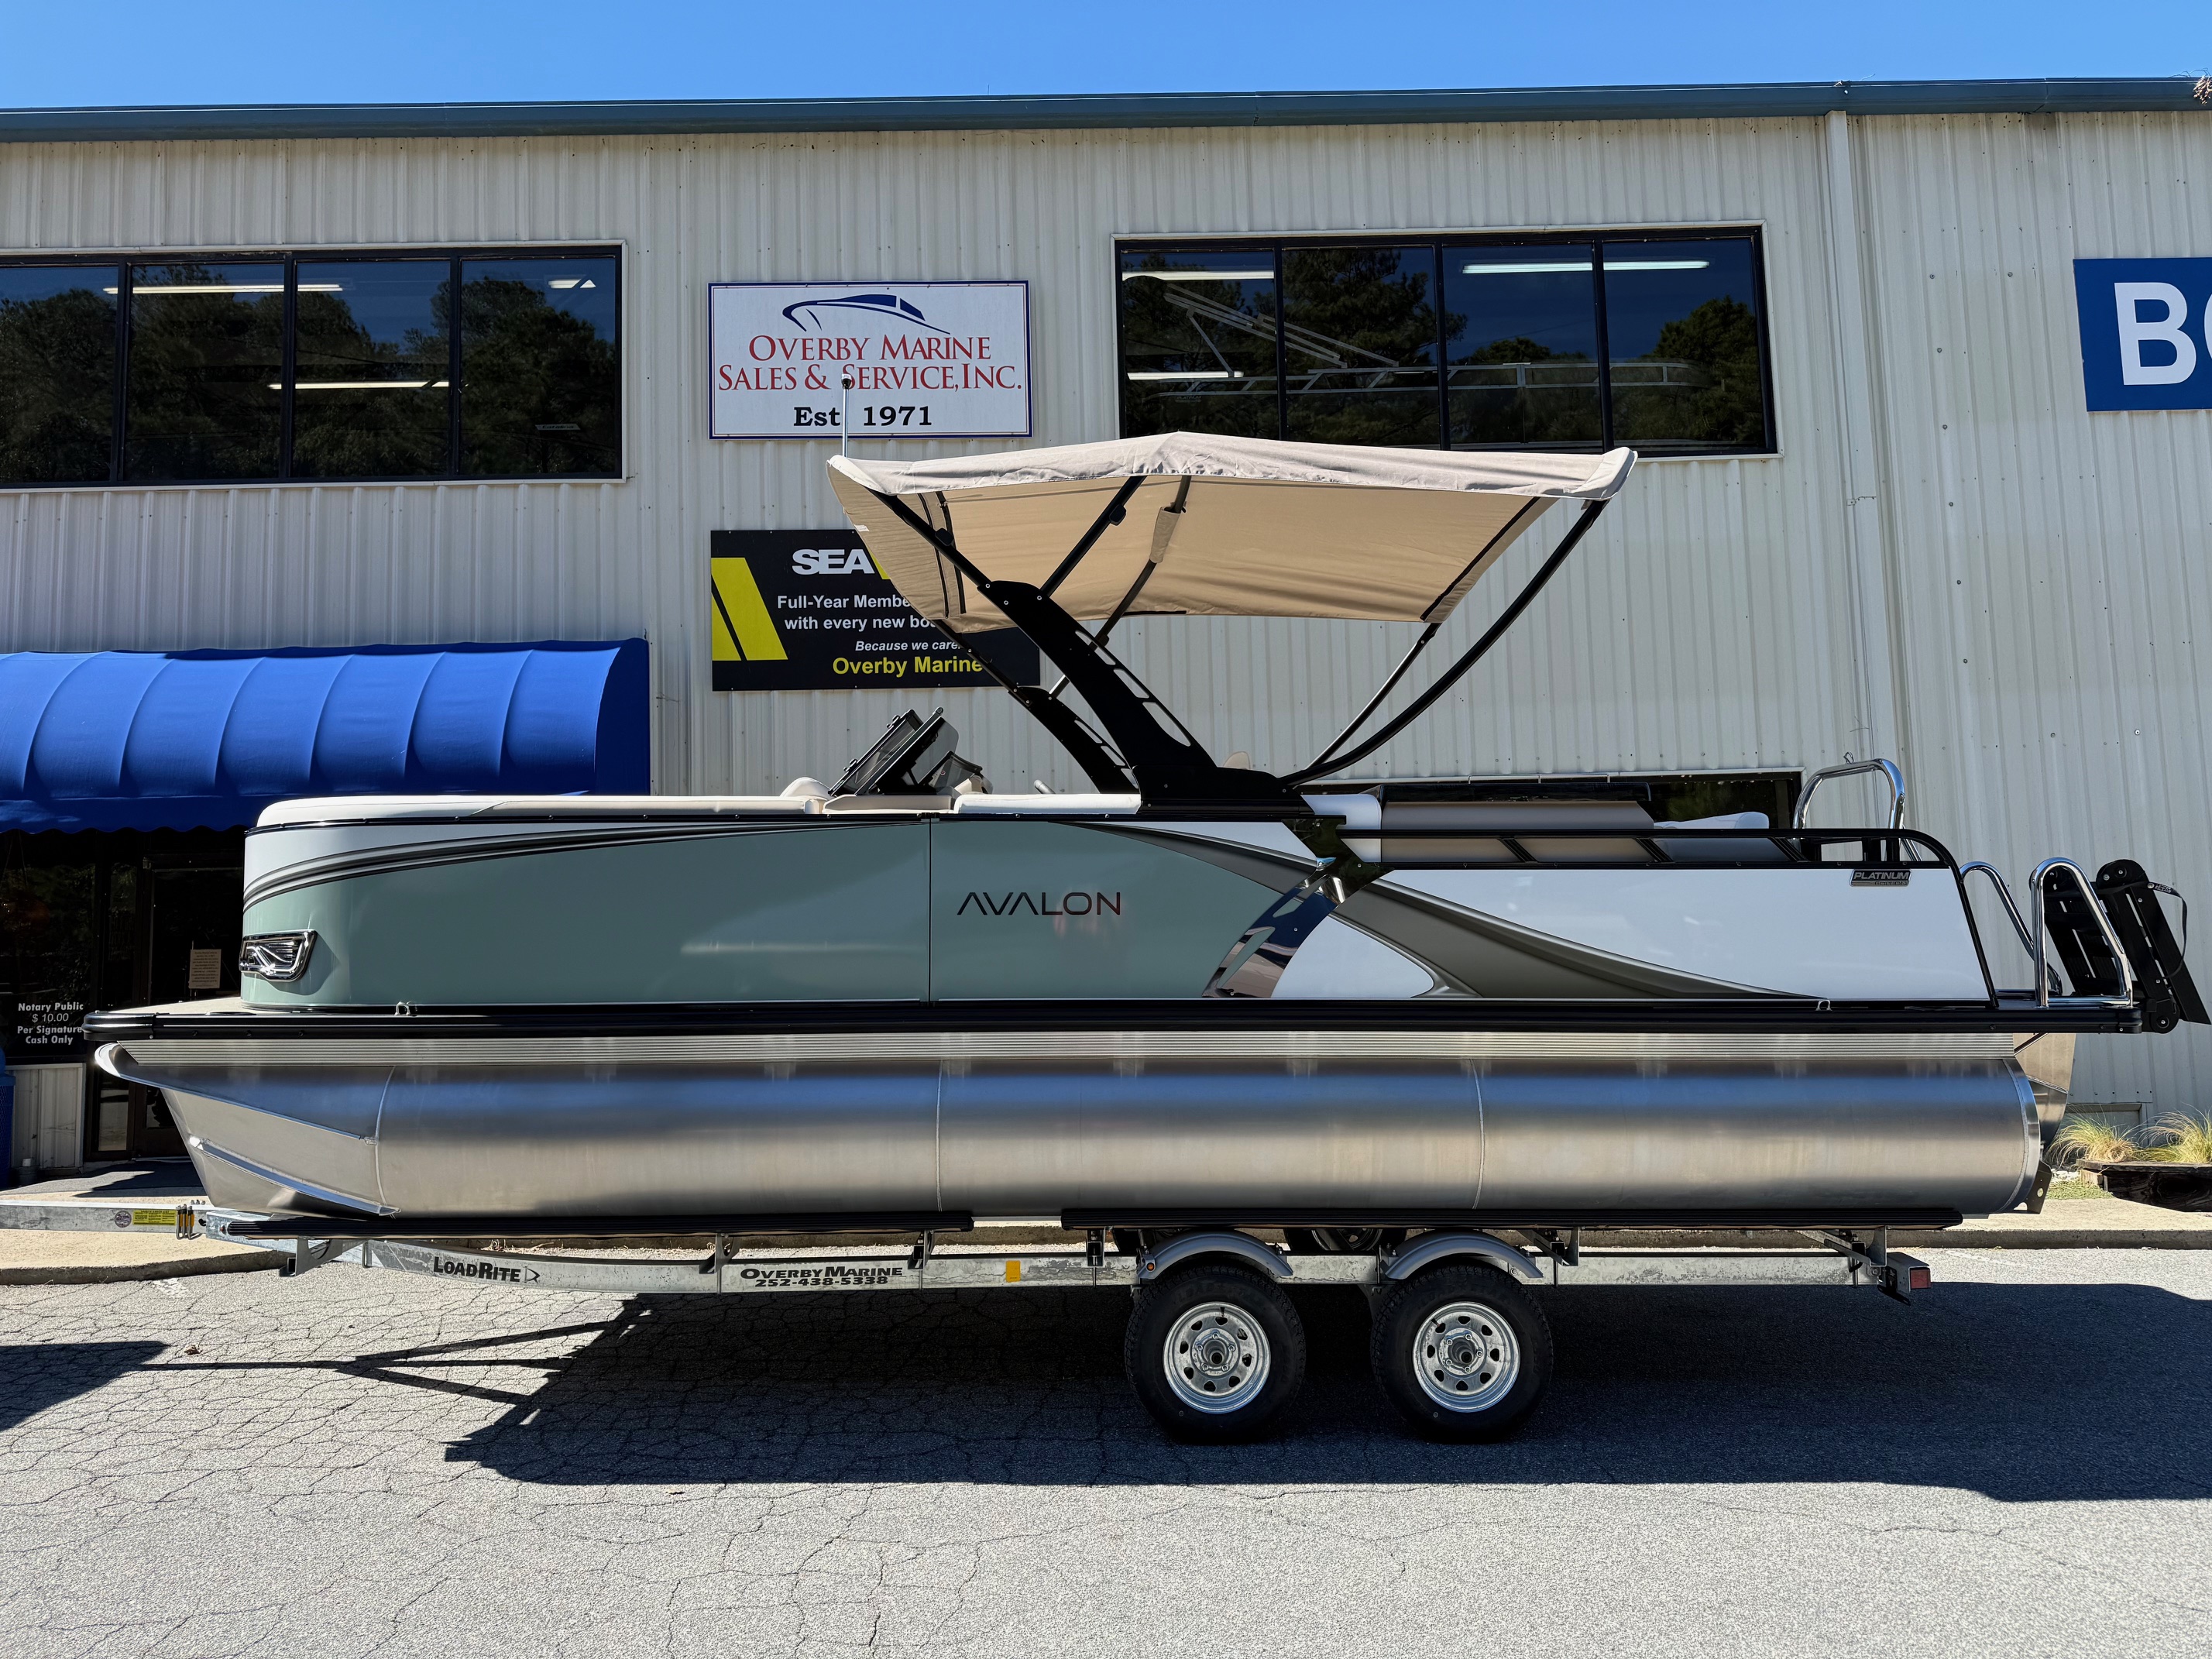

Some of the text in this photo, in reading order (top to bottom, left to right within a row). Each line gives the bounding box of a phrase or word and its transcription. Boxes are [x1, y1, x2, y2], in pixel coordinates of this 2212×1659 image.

[2114, 281, 2212, 386] B
[748, 334, 991, 361] OVERBY MARINE
[718, 364, 798, 391] SALES
[804, 363, 832, 390] &
[793, 405, 932, 427] Est 1971
[792, 548, 875, 575] SEA
[777, 594, 911, 609] Full-Year Membe
[785, 616, 819, 630] with
[823, 617, 867, 632] every
[872, 617, 905, 629] new
[855, 641, 908, 651] Because
[911, 641, 929, 650] we
[833, 655, 983, 678] Overby Marine
[1853, 871, 1910, 880] PLATINUM
[957, 891, 1121, 915] AVALON
[18, 1001, 84, 1012] Notary Public
[42, 1012, 69, 1022] 10.00
[17, 1025, 82, 1036] Per Signature
[26, 1035, 74, 1046] Cash Only
[740, 1266, 903, 1279] OVERBY MARINE
[754, 1276, 888, 1287] 252-438-5338
